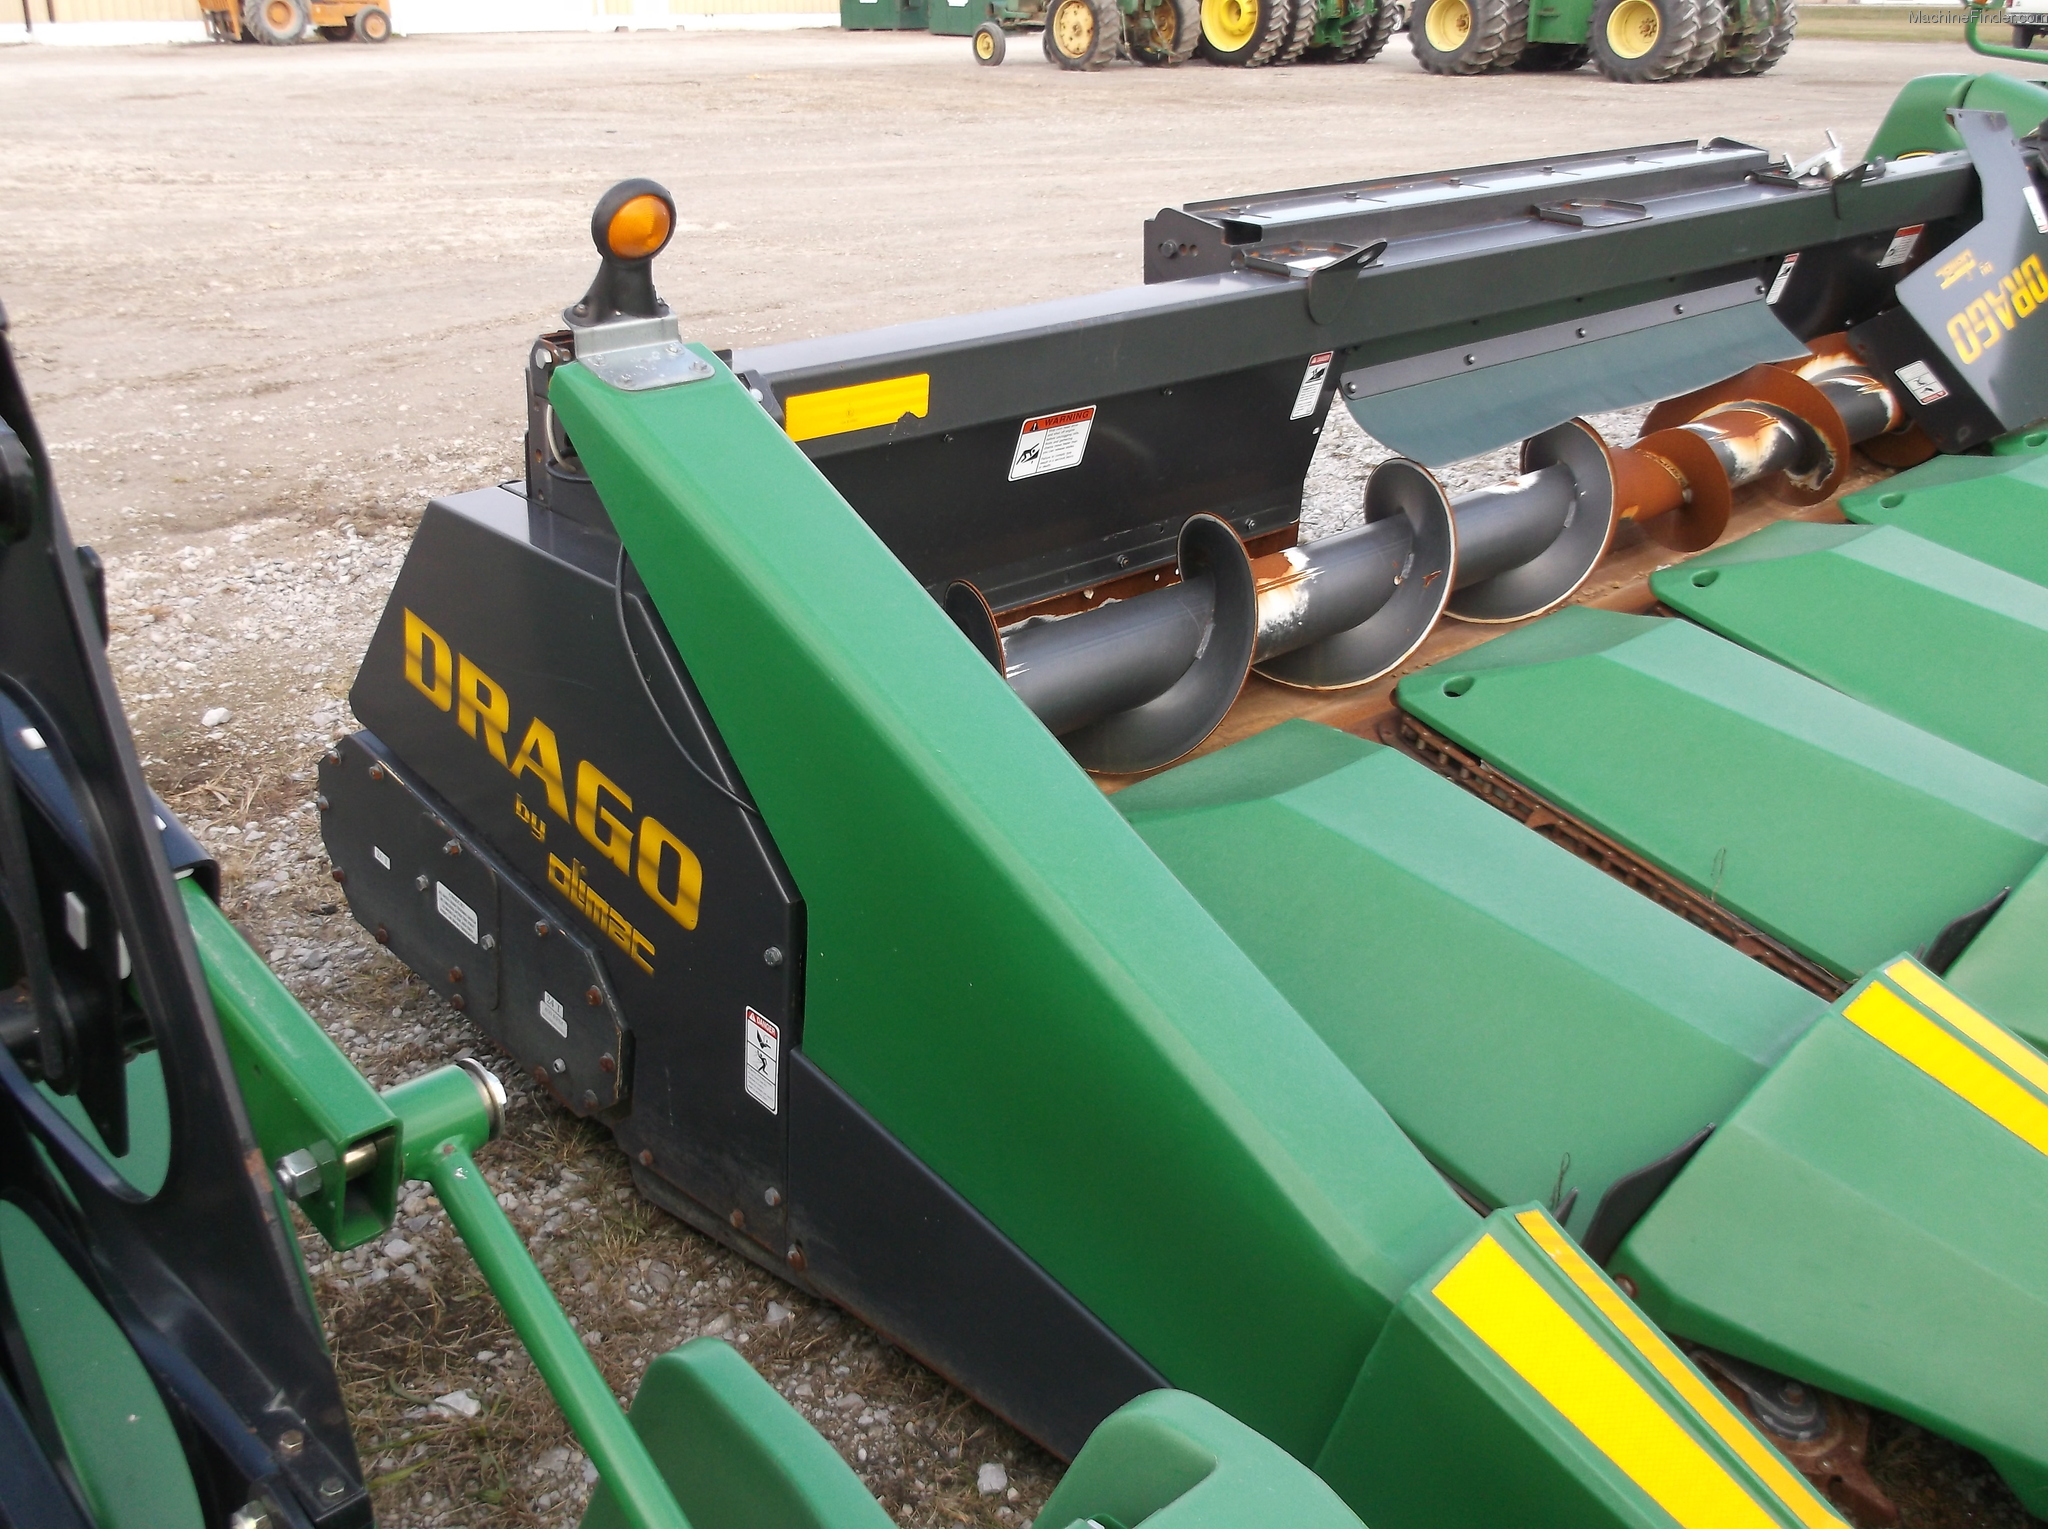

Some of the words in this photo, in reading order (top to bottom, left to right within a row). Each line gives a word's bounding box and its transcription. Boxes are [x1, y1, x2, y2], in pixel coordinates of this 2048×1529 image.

[1946, 253, 2048, 365] DRAGO
[1044, 410, 1090, 427] WARNING
[404, 606, 703, 931] DRAGO
[515, 792, 546, 843] by
[548, 851, 656, 977] olimac
[756, 1015, 776, 1035] DANGER
